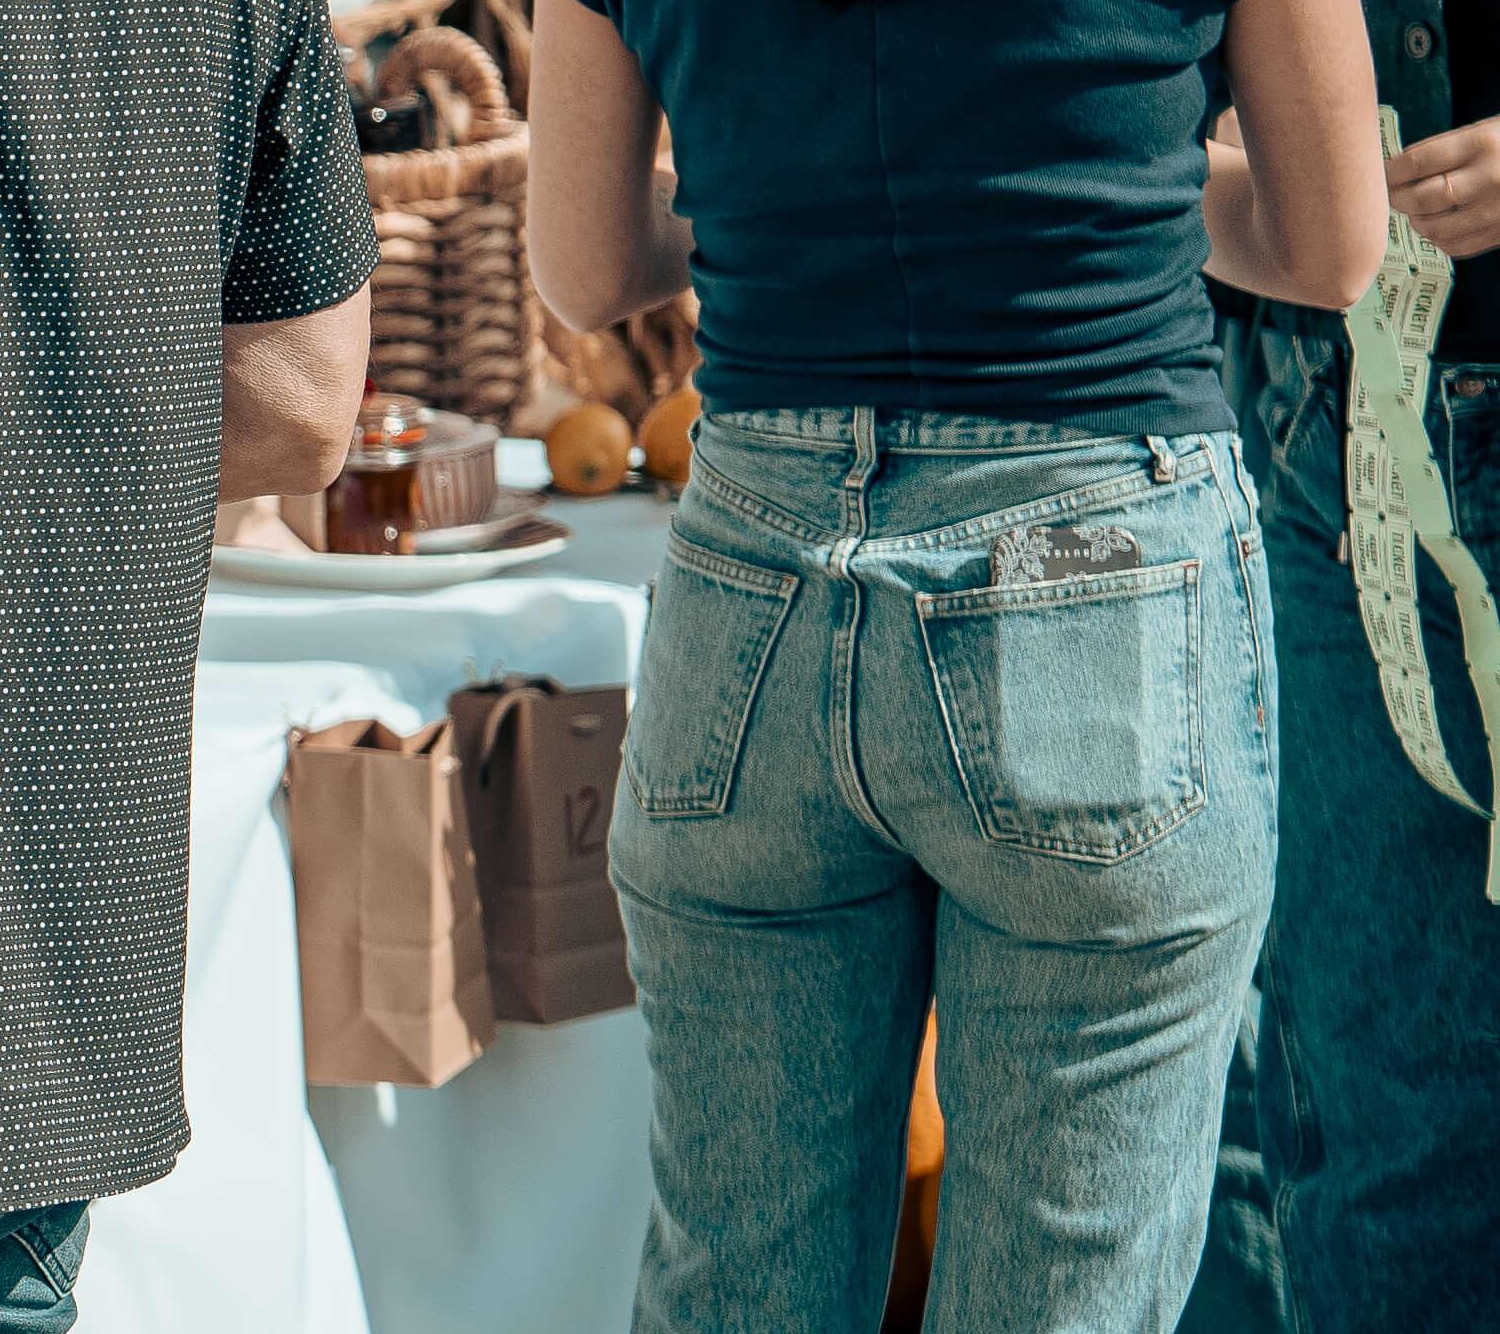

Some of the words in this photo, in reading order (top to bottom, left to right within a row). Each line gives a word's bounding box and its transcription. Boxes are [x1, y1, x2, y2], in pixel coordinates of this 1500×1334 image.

[1410, 281, 1438, 334] TICKET
[1402, 364, 1418, 397] TICK
[1391, 530, 1407, 582] TICKET
